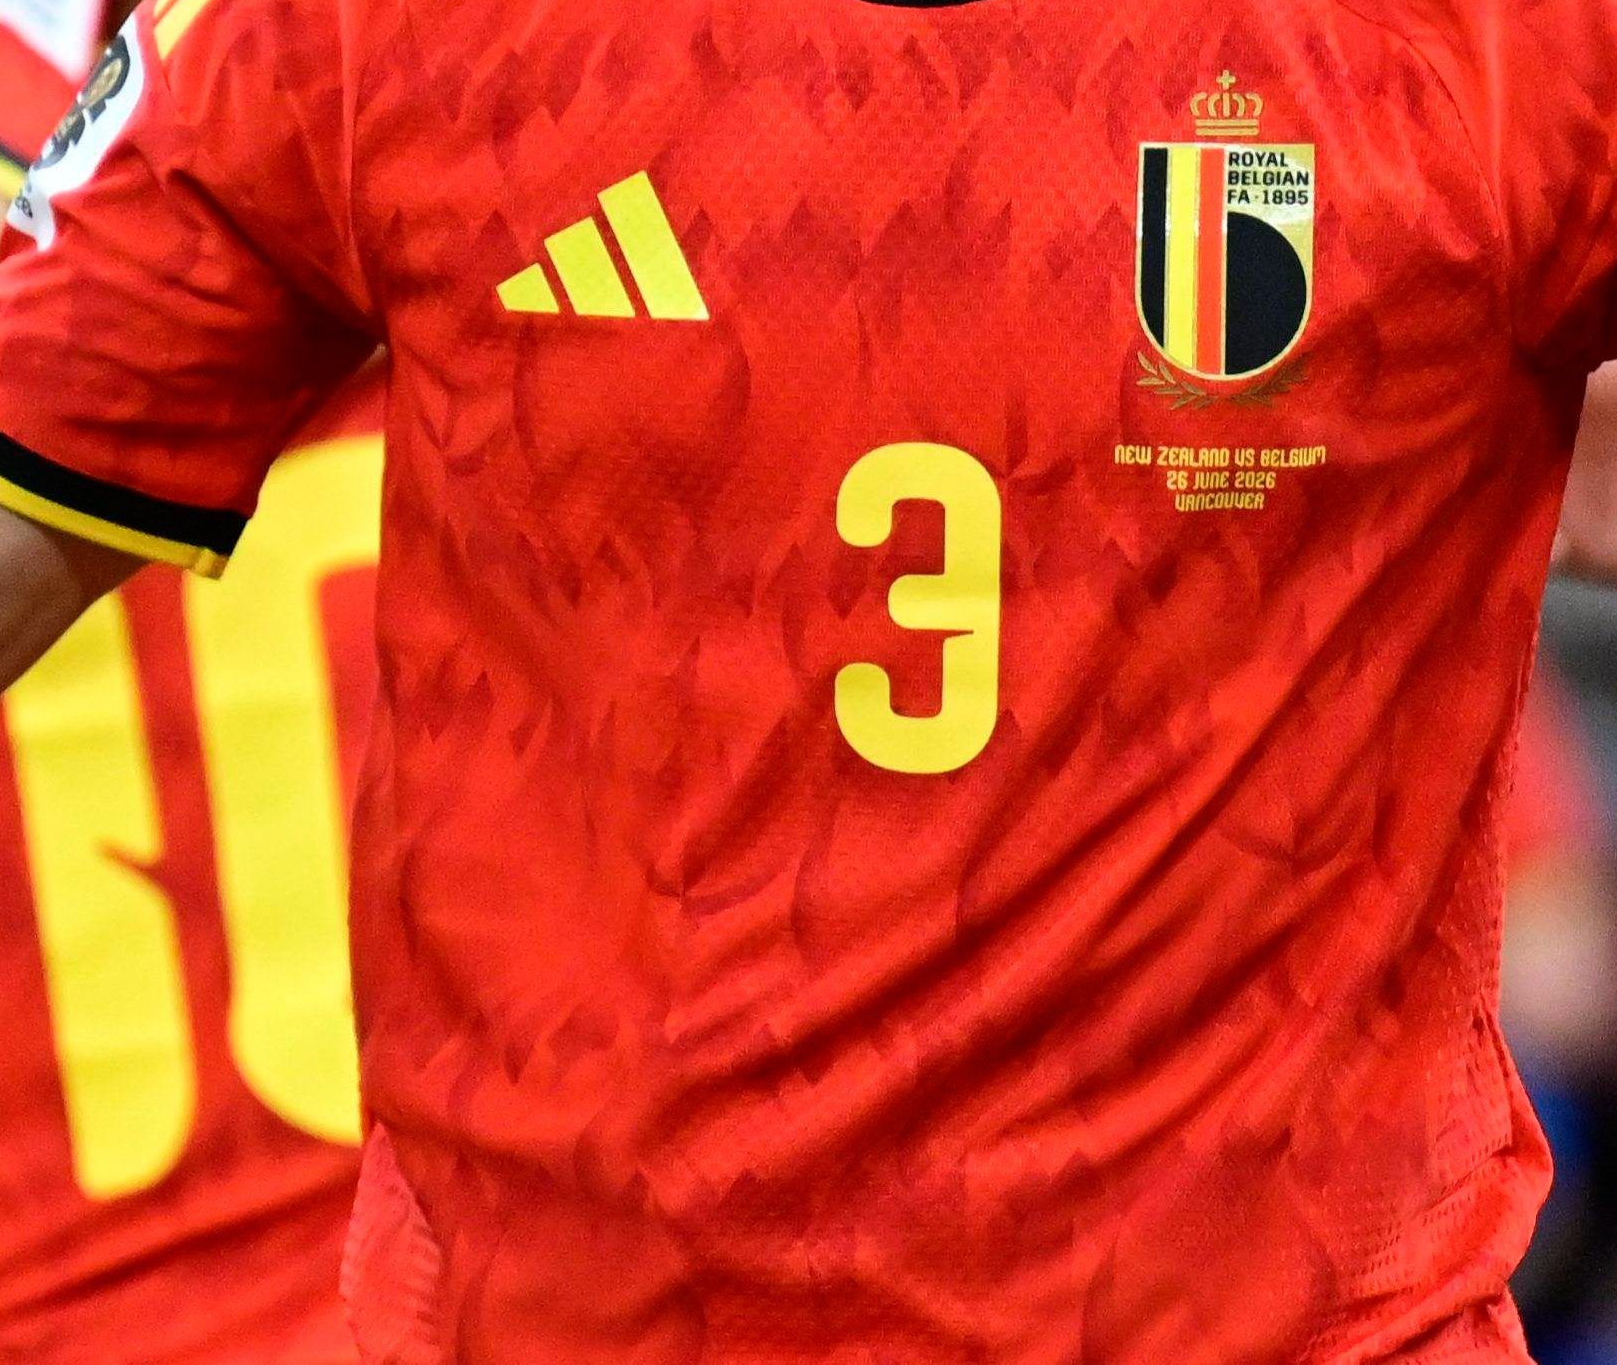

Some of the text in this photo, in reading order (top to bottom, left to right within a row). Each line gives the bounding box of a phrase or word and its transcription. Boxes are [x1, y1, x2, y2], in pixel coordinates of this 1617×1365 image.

[1228, 151, 1288, 168] ROYAL
[1228, 170, 1309, 186] BELGIAN
[1227, 189, 1309, 205] FA 1895
[1115, 444, 1152, 465] NEW
[1156, 445, 1230, 467] ZEALAND
[1260, 445, 1326, 467] BELGIUM
[1166, 470, 1277, 491] 26 JUNE 2026
[1174, 491, 1265, 512] VANCOUVER
[834, 441, 1002, 775] 3
